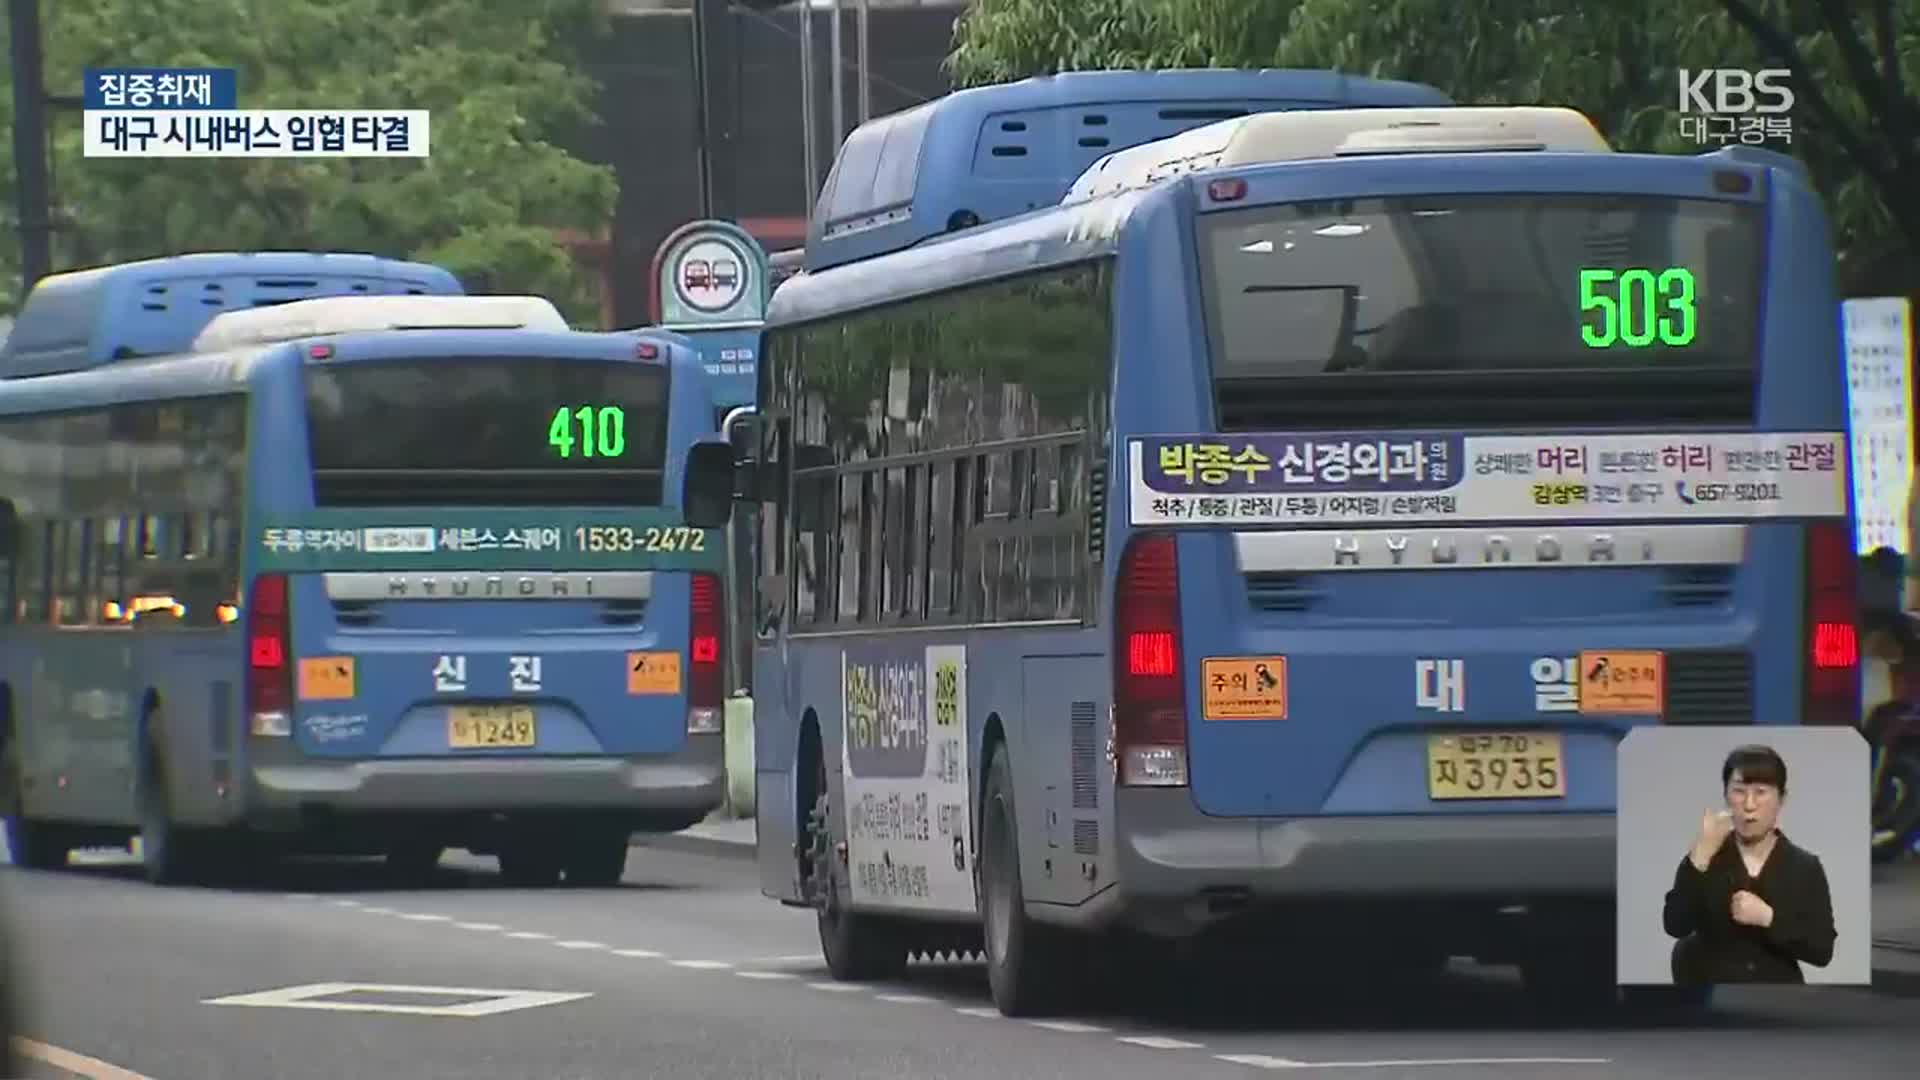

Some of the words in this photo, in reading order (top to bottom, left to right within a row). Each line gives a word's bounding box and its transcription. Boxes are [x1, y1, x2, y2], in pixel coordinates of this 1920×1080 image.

[1580, 268, 1696, 347] 503
[549, 406, 625, 458] 410
[1159, 442, 1271, 485] 박종수
[1278, 441, 1428, 484] 신경외과
[1537, 445, 1588, 474] 머리
[1661, 444, 1712, 472] 허리
[1785, 442, 1836, 471] 관절
[575, 527, 705, 552] 1533-2472
[1333, 534, 1656, 566] HYUNDAI
[1211, 672, 1247, 692] 주의
[473, 720, 531, 745] 1249
